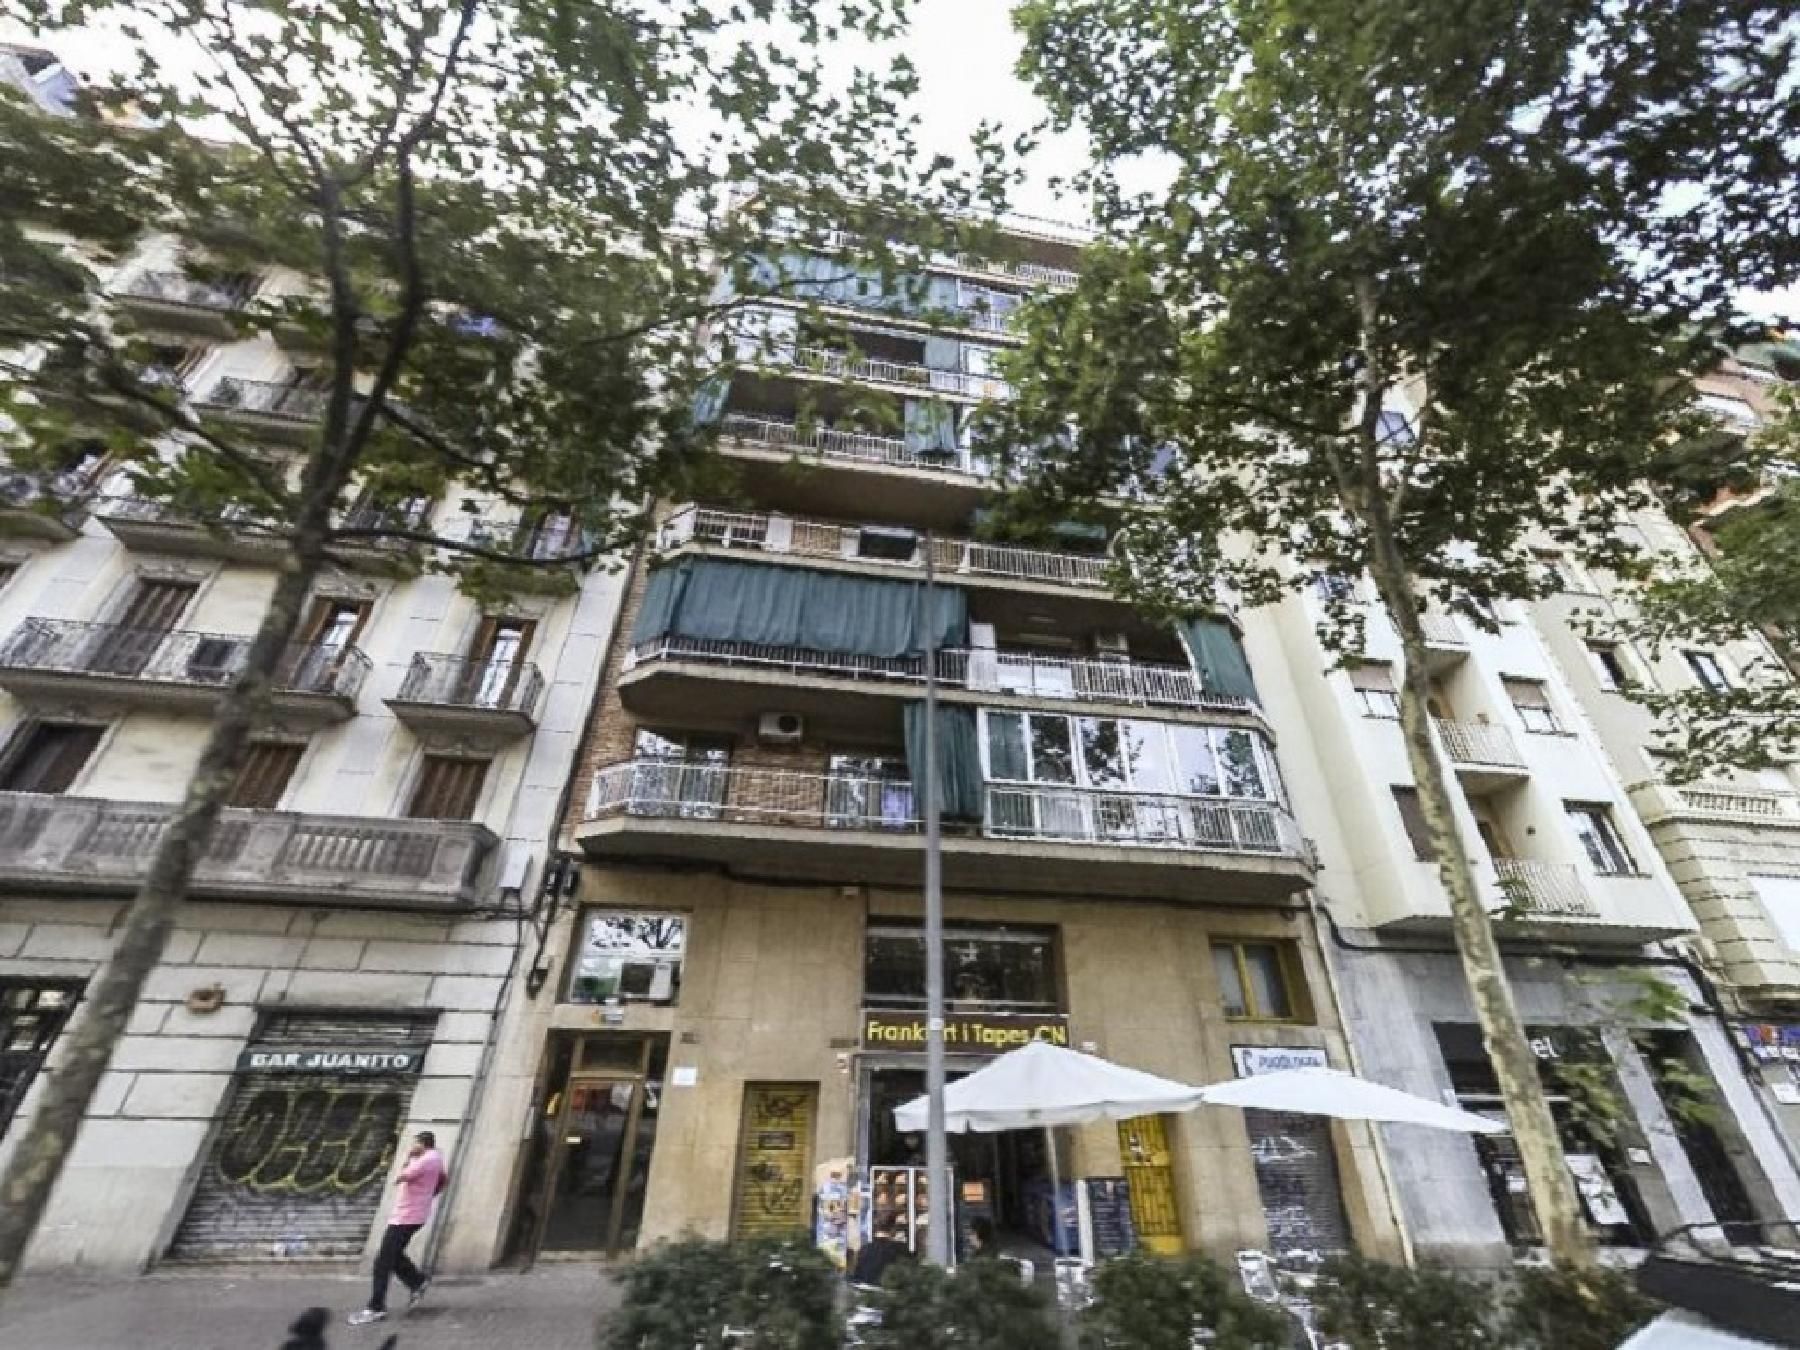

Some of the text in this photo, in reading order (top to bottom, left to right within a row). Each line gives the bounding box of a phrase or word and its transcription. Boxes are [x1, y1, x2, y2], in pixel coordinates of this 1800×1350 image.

[867, 1020, 957, 1041] Frankrt
[972, 1023, 1030, 1048] Tapes
[250, 1053, 410, 1069] BAR JUANITO
